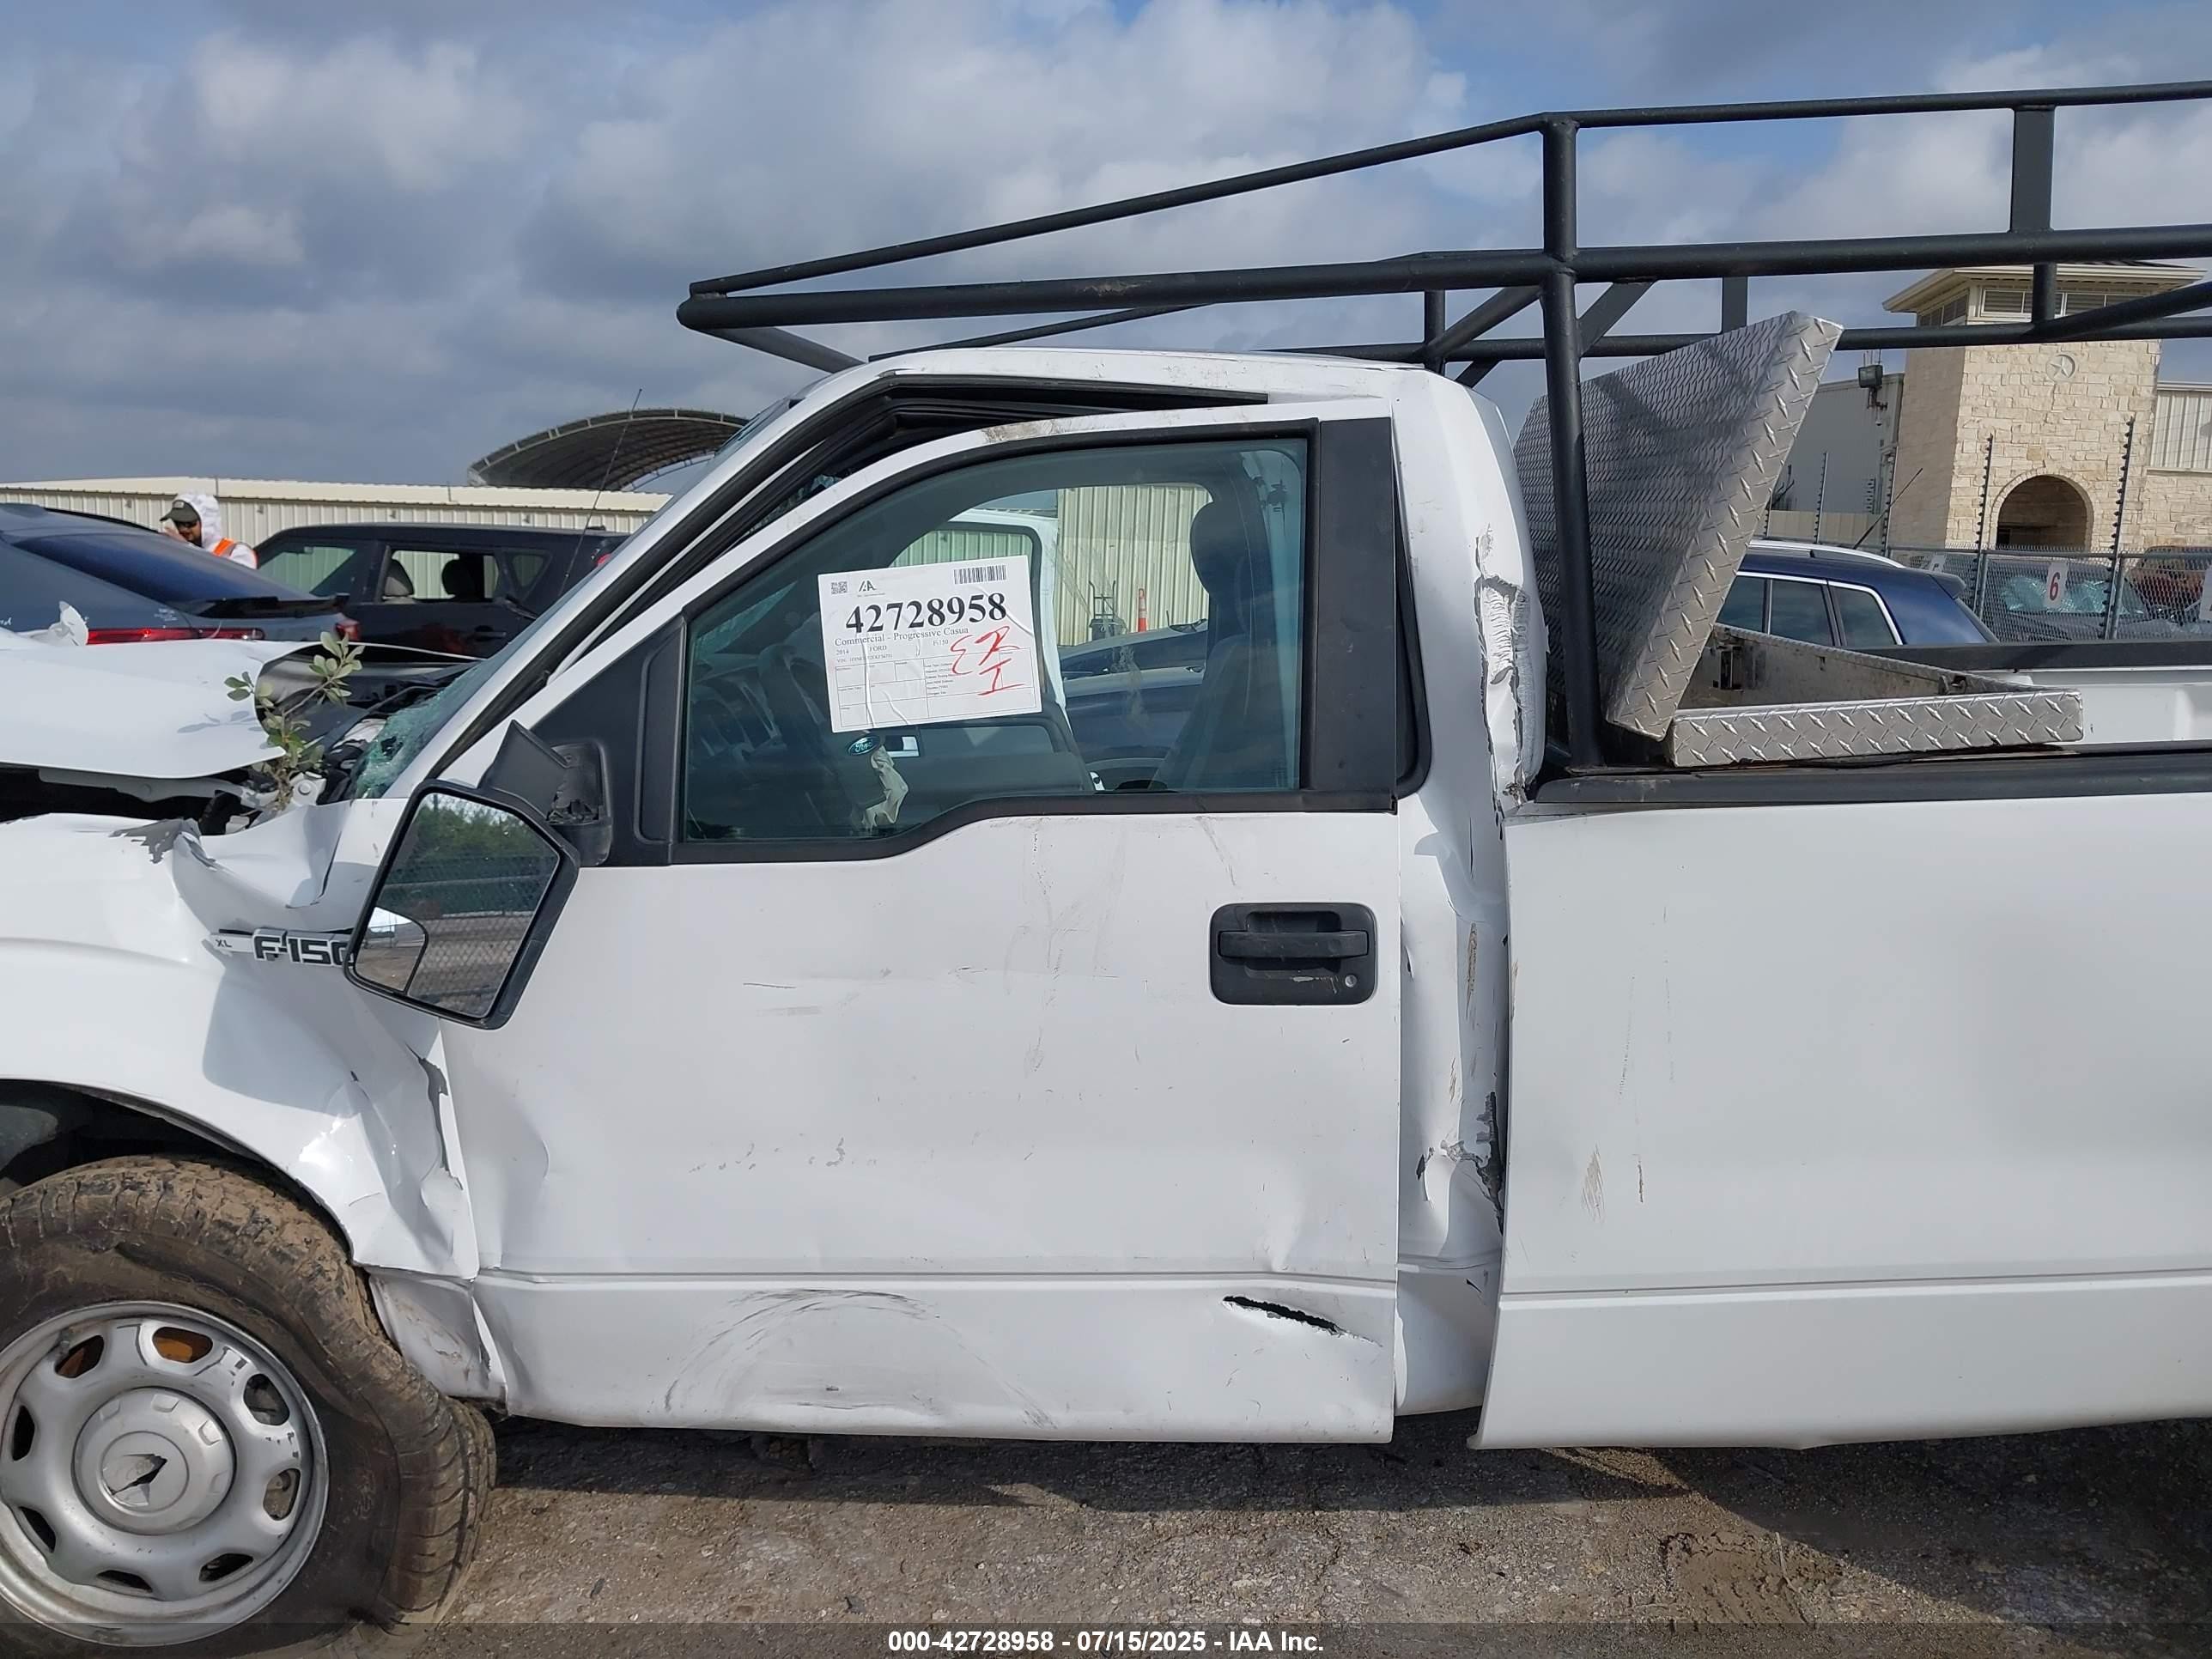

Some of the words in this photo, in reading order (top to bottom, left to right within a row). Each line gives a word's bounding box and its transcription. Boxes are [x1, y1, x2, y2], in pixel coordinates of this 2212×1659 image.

[2050, 572, 2060, 600] 6
[846, 592, 1006, 633] 42728958
[835, 633, 885, 647] Commercial
[893, 629, 942, 642] Progressive
[943, 627, 969, 636] Casua
[215, 939, 233, 949] XL
